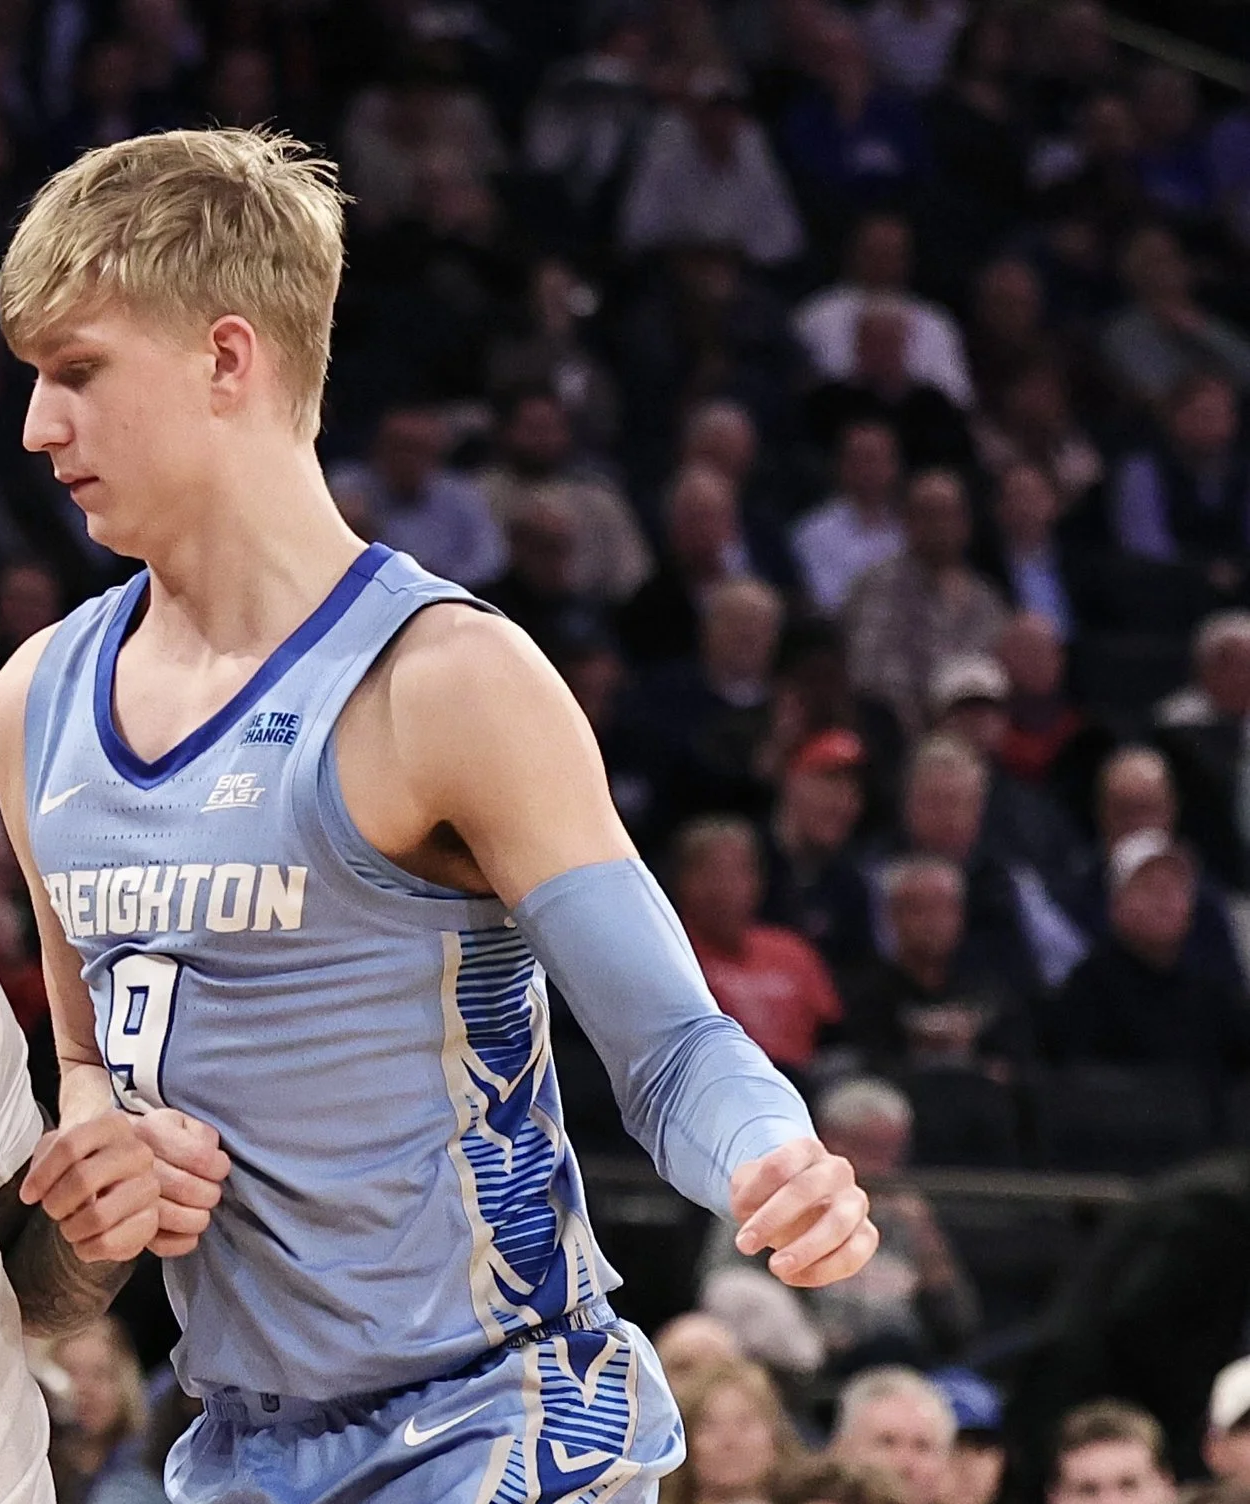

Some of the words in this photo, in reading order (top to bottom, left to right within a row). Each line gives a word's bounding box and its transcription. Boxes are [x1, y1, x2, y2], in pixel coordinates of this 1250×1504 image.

[268, 712, 299, 729] THE
[215, 773, 257, 790] BIG
[206, 787, 266, 804] EAST
[41, 863, 309, 938] REIGHTON
[105, 948, 184, 1116] 9
